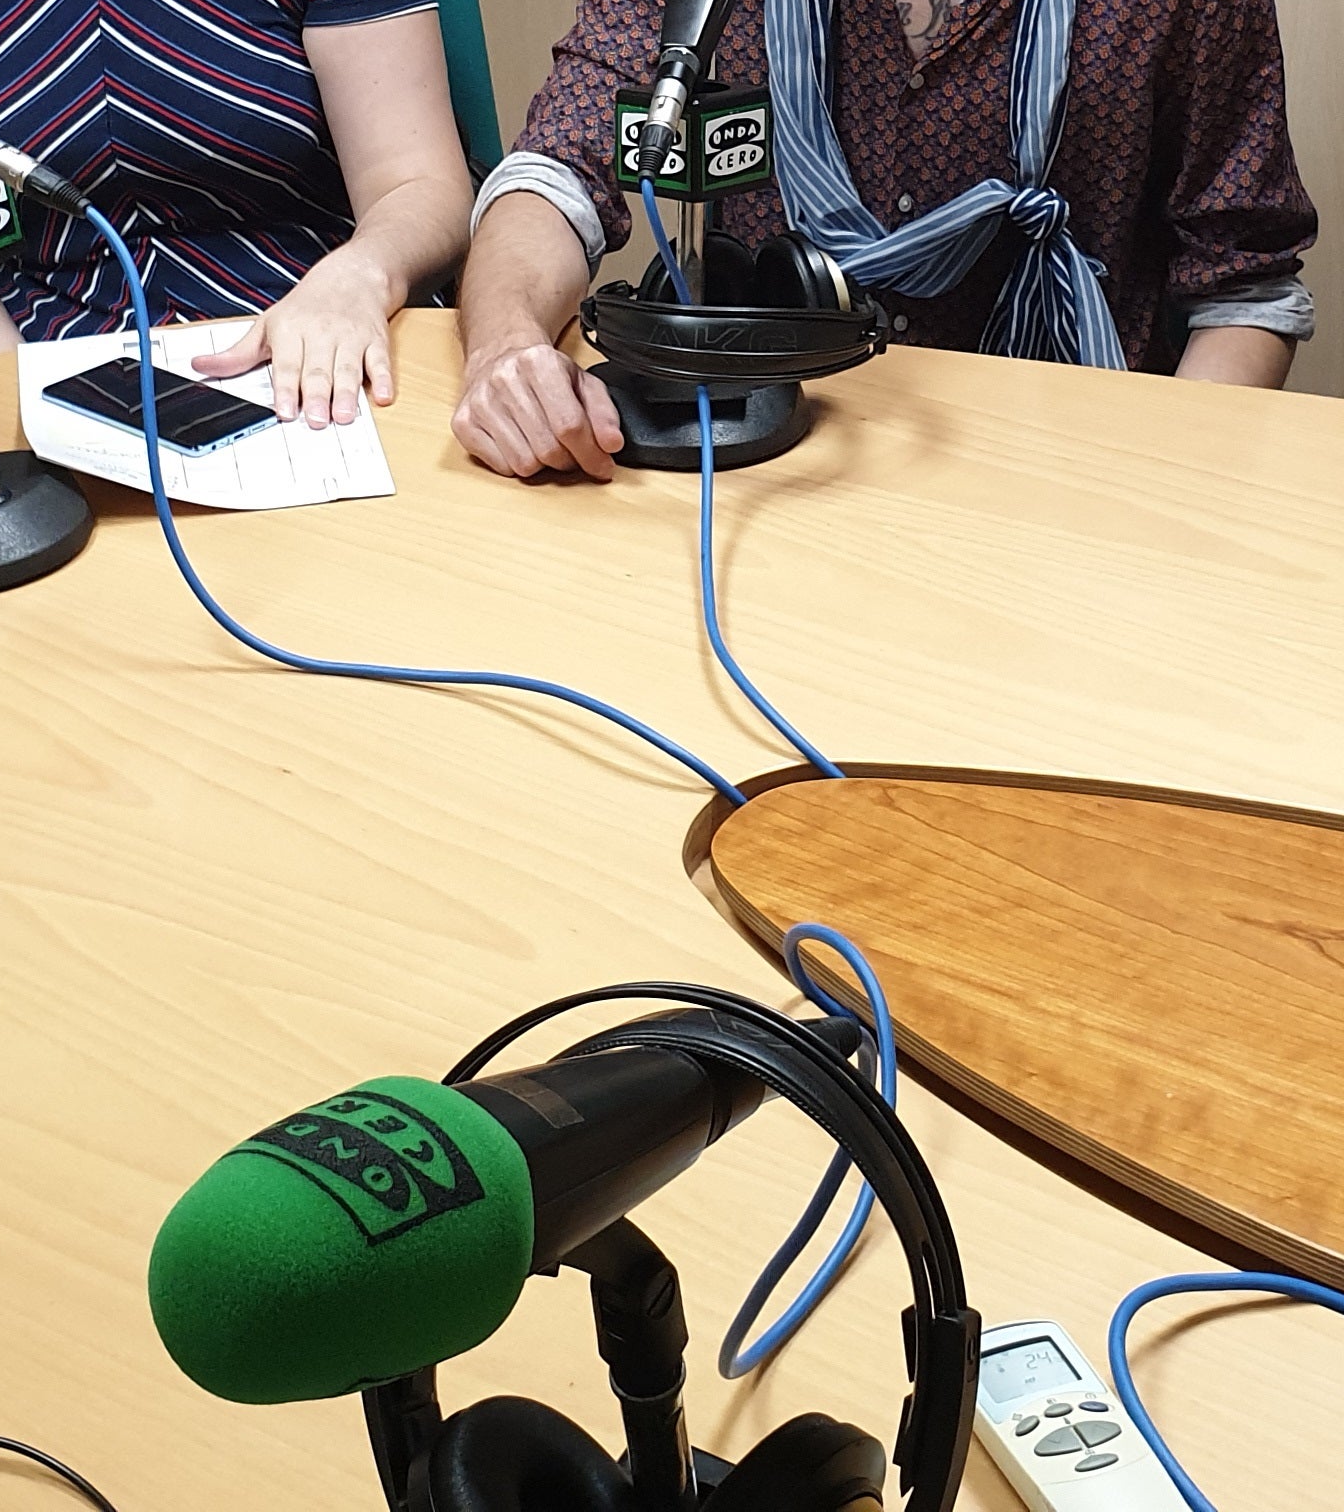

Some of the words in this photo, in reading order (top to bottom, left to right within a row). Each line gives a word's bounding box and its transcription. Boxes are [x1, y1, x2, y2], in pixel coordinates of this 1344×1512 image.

[713, 123, 758, 141] ONDA
[716, 149, 758, 170] CERO
[326, 1099, 434, 1163] CER
[284, 1122, 394, 1193] OND
[1024, 1351, 1052, 1369] 24
